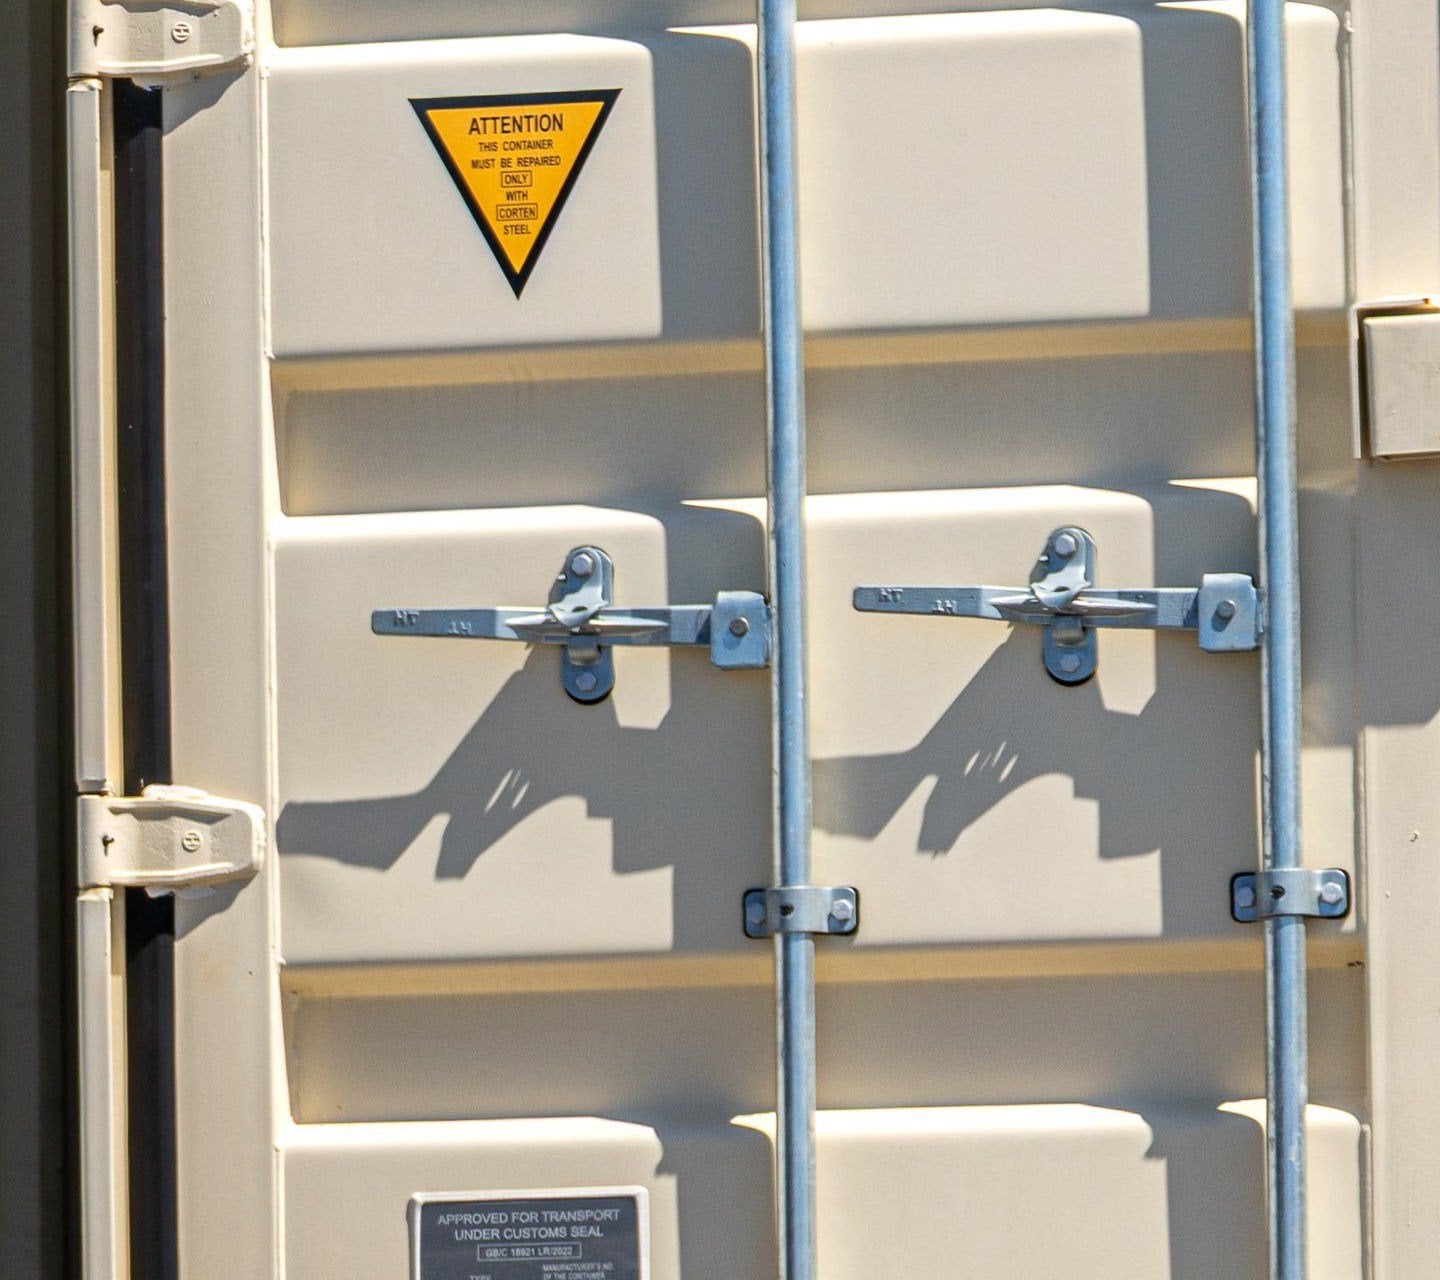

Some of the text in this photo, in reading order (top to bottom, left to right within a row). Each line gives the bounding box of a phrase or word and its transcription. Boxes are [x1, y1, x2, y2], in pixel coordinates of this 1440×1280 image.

[468, 113, 564, 135] ATTENTION
[479, 138, 553, 152] THIS CONTAINER
[471, 154, 561, 169] MUST BE REPAIRED
[504, 173, 529, 185] ONLY
[506, 190, 529, 201] WITH
[498, 206, 536, 218] CORTEN
[503, 224, 531, 235] STEEL
[438, 1209, 621, 1225] APPROVED FOR TRANSPORT
[455, 1225, 604, 1240] UNDER CUSTOMS SEAL
